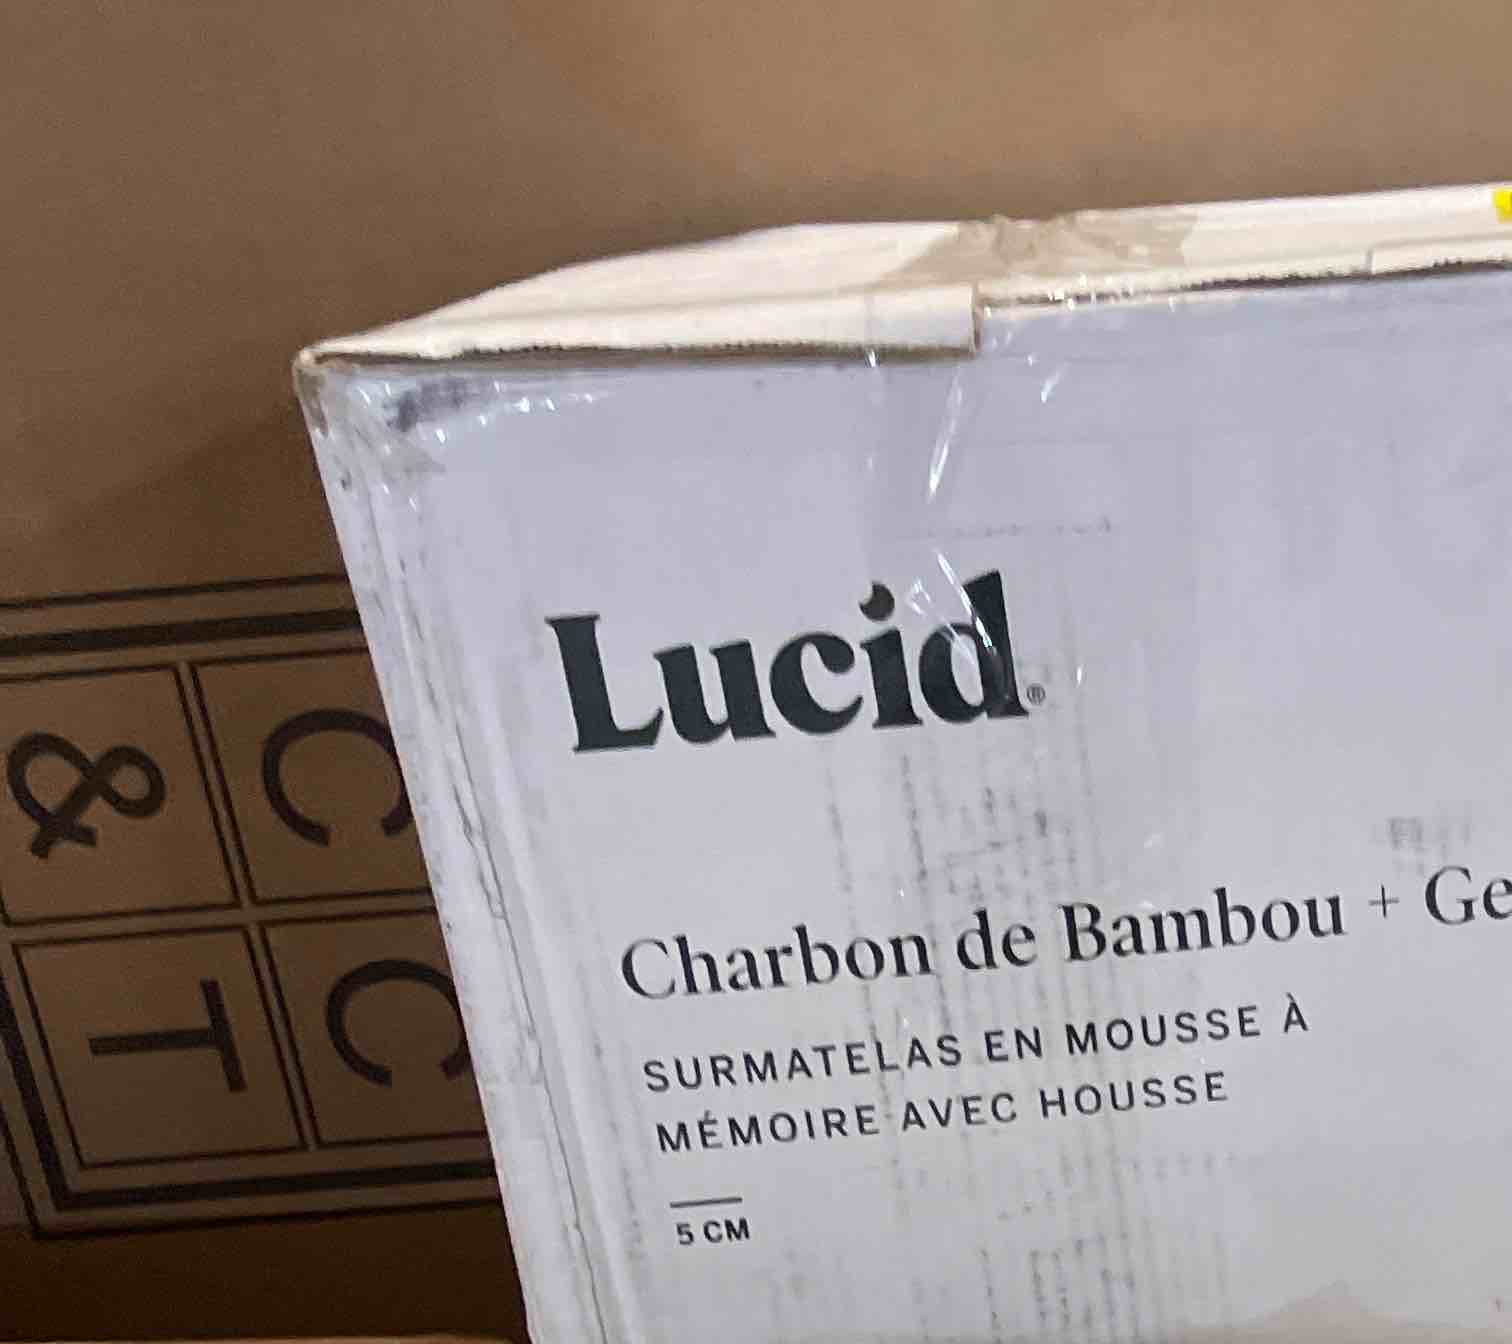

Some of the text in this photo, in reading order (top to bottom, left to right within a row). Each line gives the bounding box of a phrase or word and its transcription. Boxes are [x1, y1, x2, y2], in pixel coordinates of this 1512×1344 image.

[545, 568, 1029, 754] Lucid
[620, 924, 933, 1001] Charbon
[956, 909, 1037, 974] de
[1060, 885, 1346, 965] Bambou
[642, 992, 1309, 1094] SURMATELAS EN MOUSSE À
[656, 1069, 1230, 1155] MÉMOIRE AVEC HOUSSE
[675, 1216, 752, 1246] 5 CM
